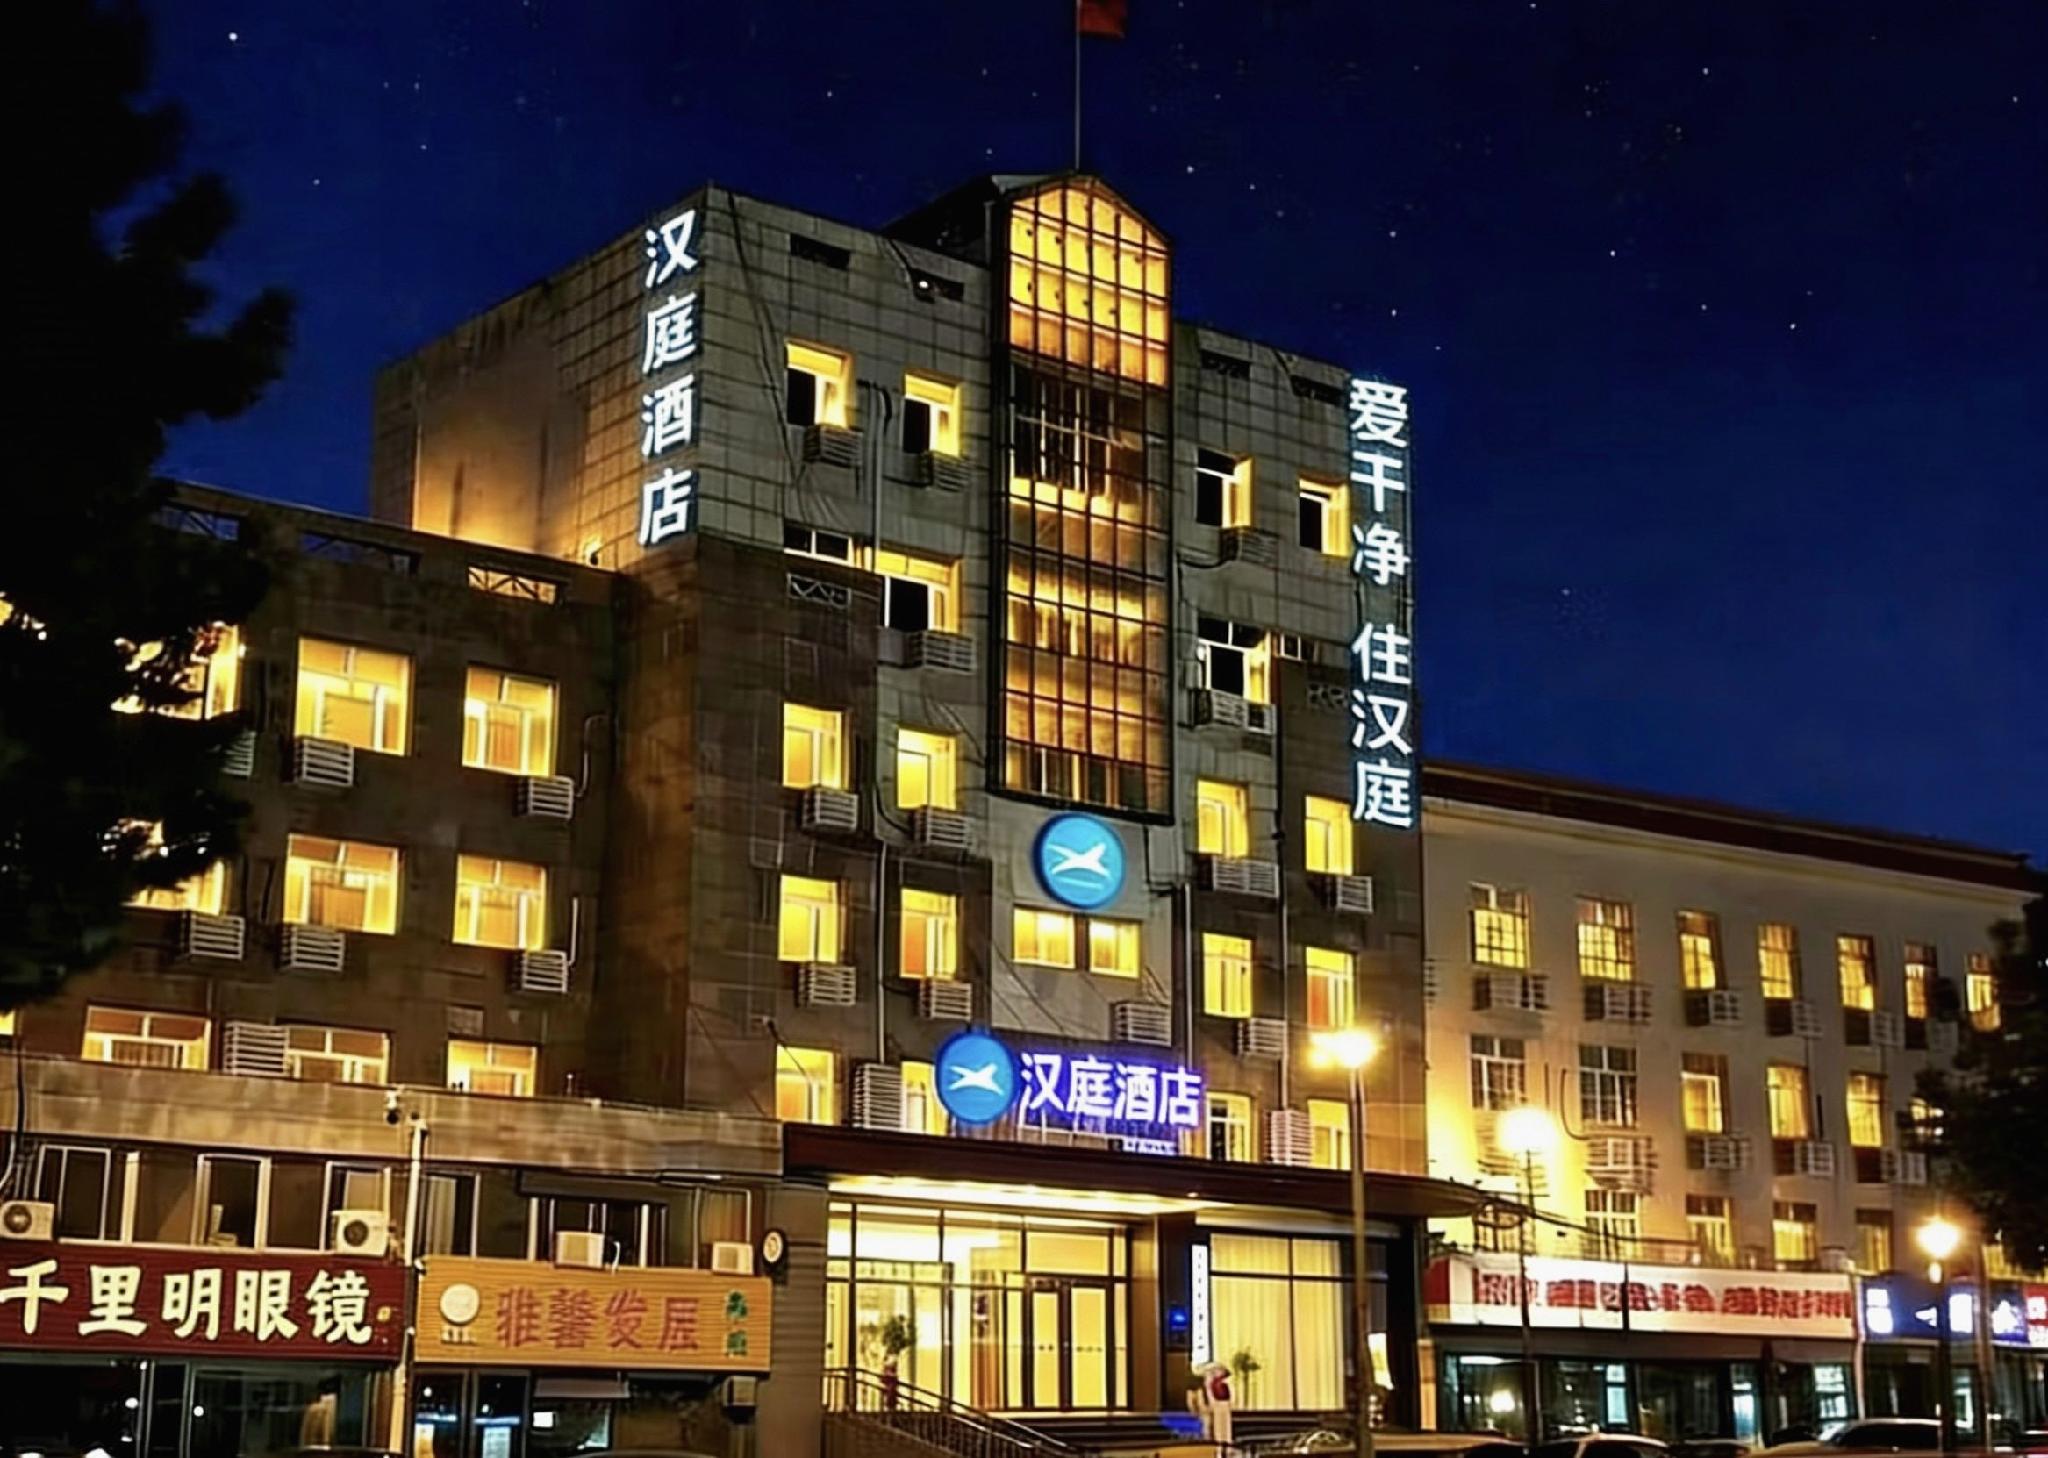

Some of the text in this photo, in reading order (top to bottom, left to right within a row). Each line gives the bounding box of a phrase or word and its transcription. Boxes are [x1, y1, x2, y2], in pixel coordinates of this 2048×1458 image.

[639, 209, 698, 545] 汉庭酒店
[1350, 378, 1412, 828] 爱干净 住汉庭
[1020, 1053, 1202, 1126] 汉庭酒店
[0, 1258, 373, 1345] 千里明眼镜
